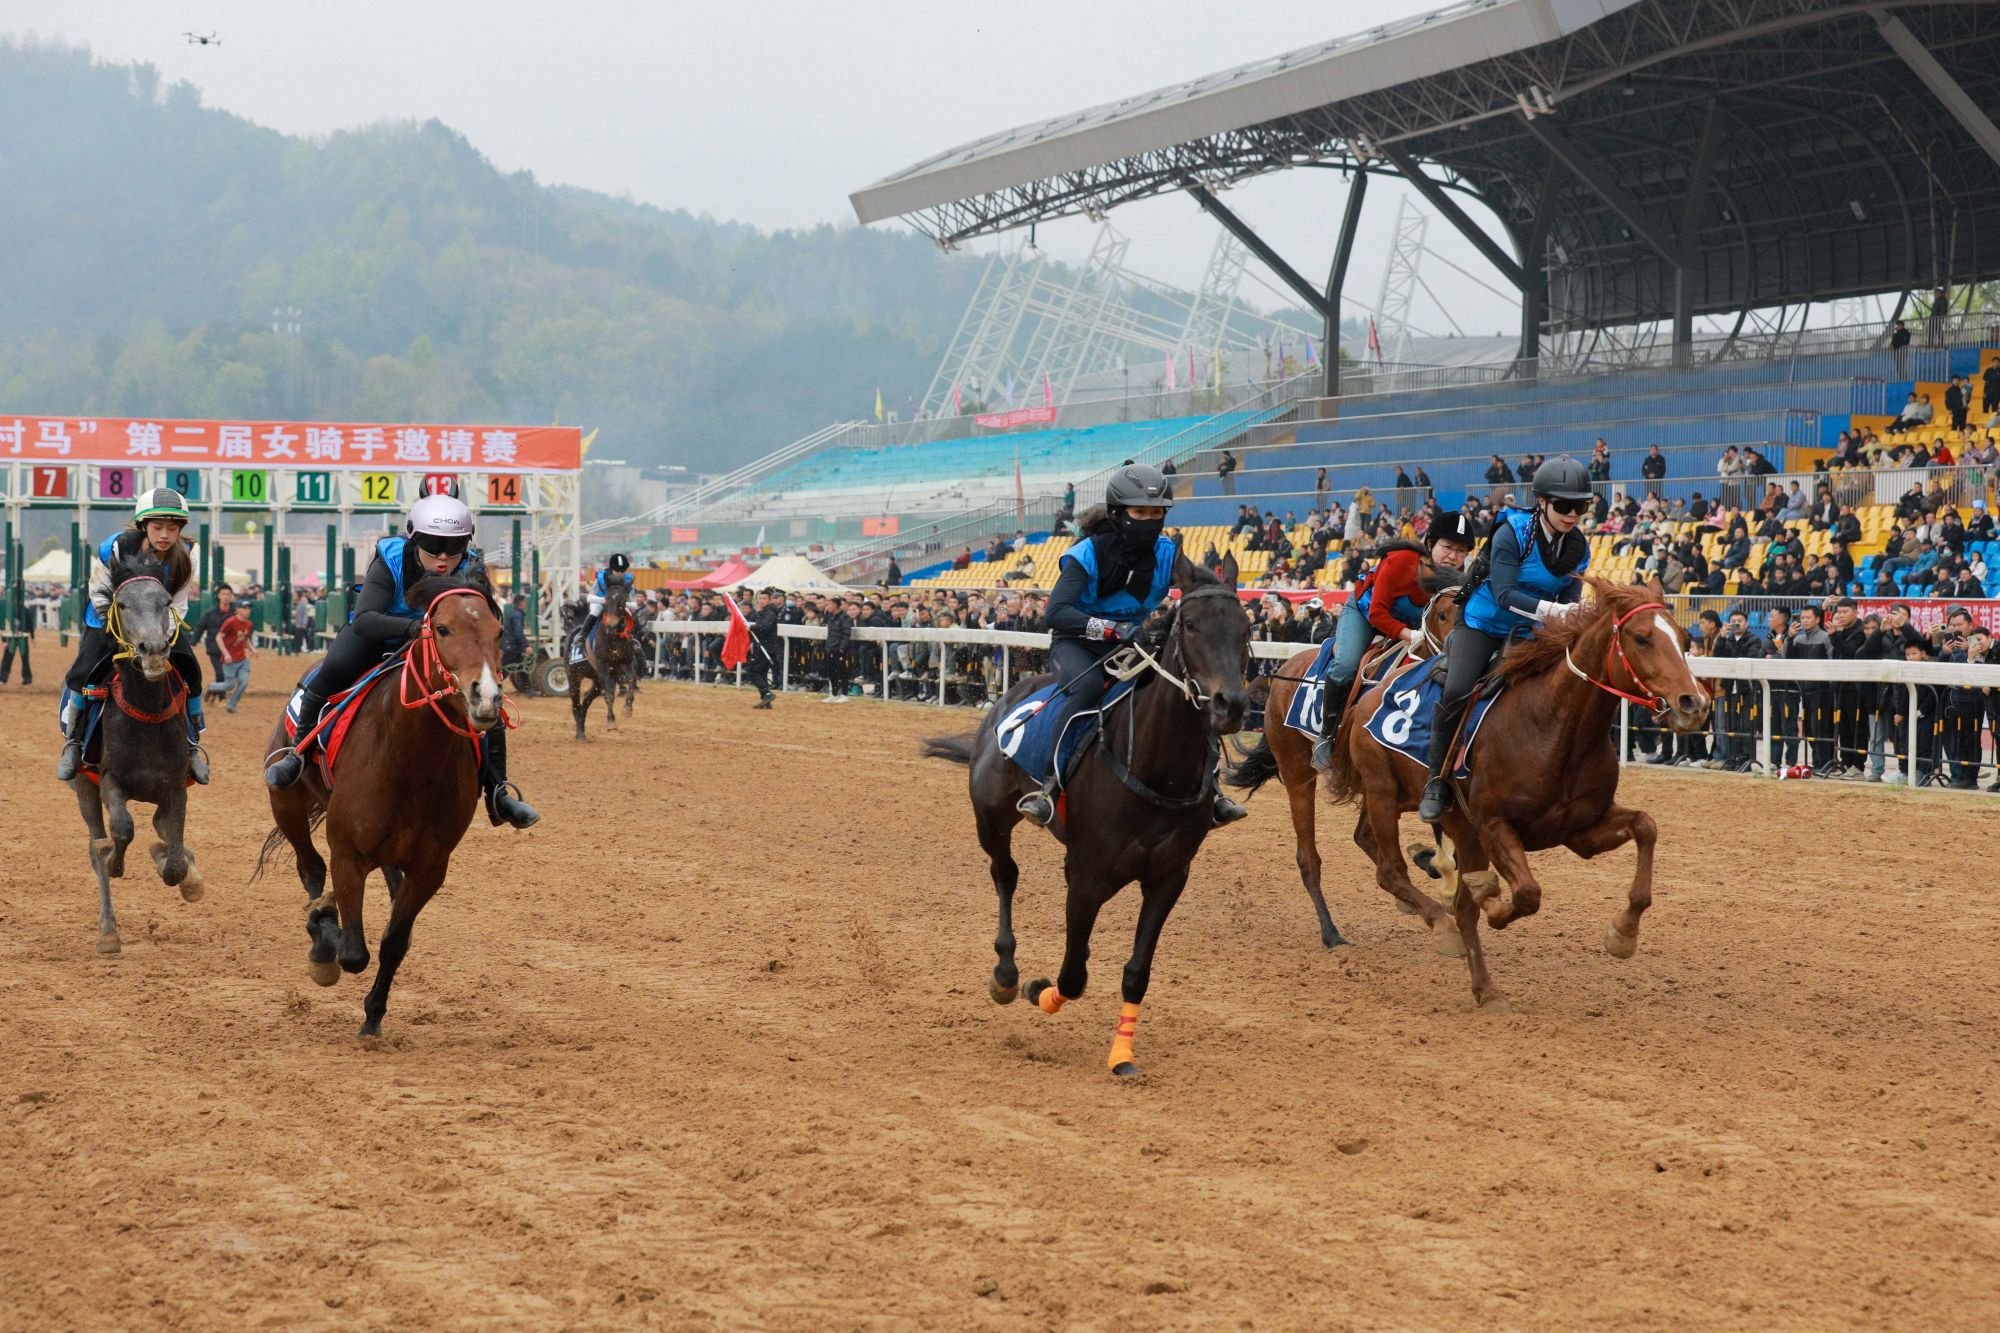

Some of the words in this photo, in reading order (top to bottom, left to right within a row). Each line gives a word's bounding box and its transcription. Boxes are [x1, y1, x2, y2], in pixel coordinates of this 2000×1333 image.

[42, 469, 57, 496] 7
[110, 471, 123, 495] 8
[176, 472, 189, 496] 9
[236, 473, 262, 498] 10
[300, 474, 330, 500] 11
[364, 476, 391, 500] 12
[427, 475, 452, 497] 13
[491, 477, 517, 501] 14
[997, 700, 1044, 758] 6
[1382, 689, 1421, 745] 8
